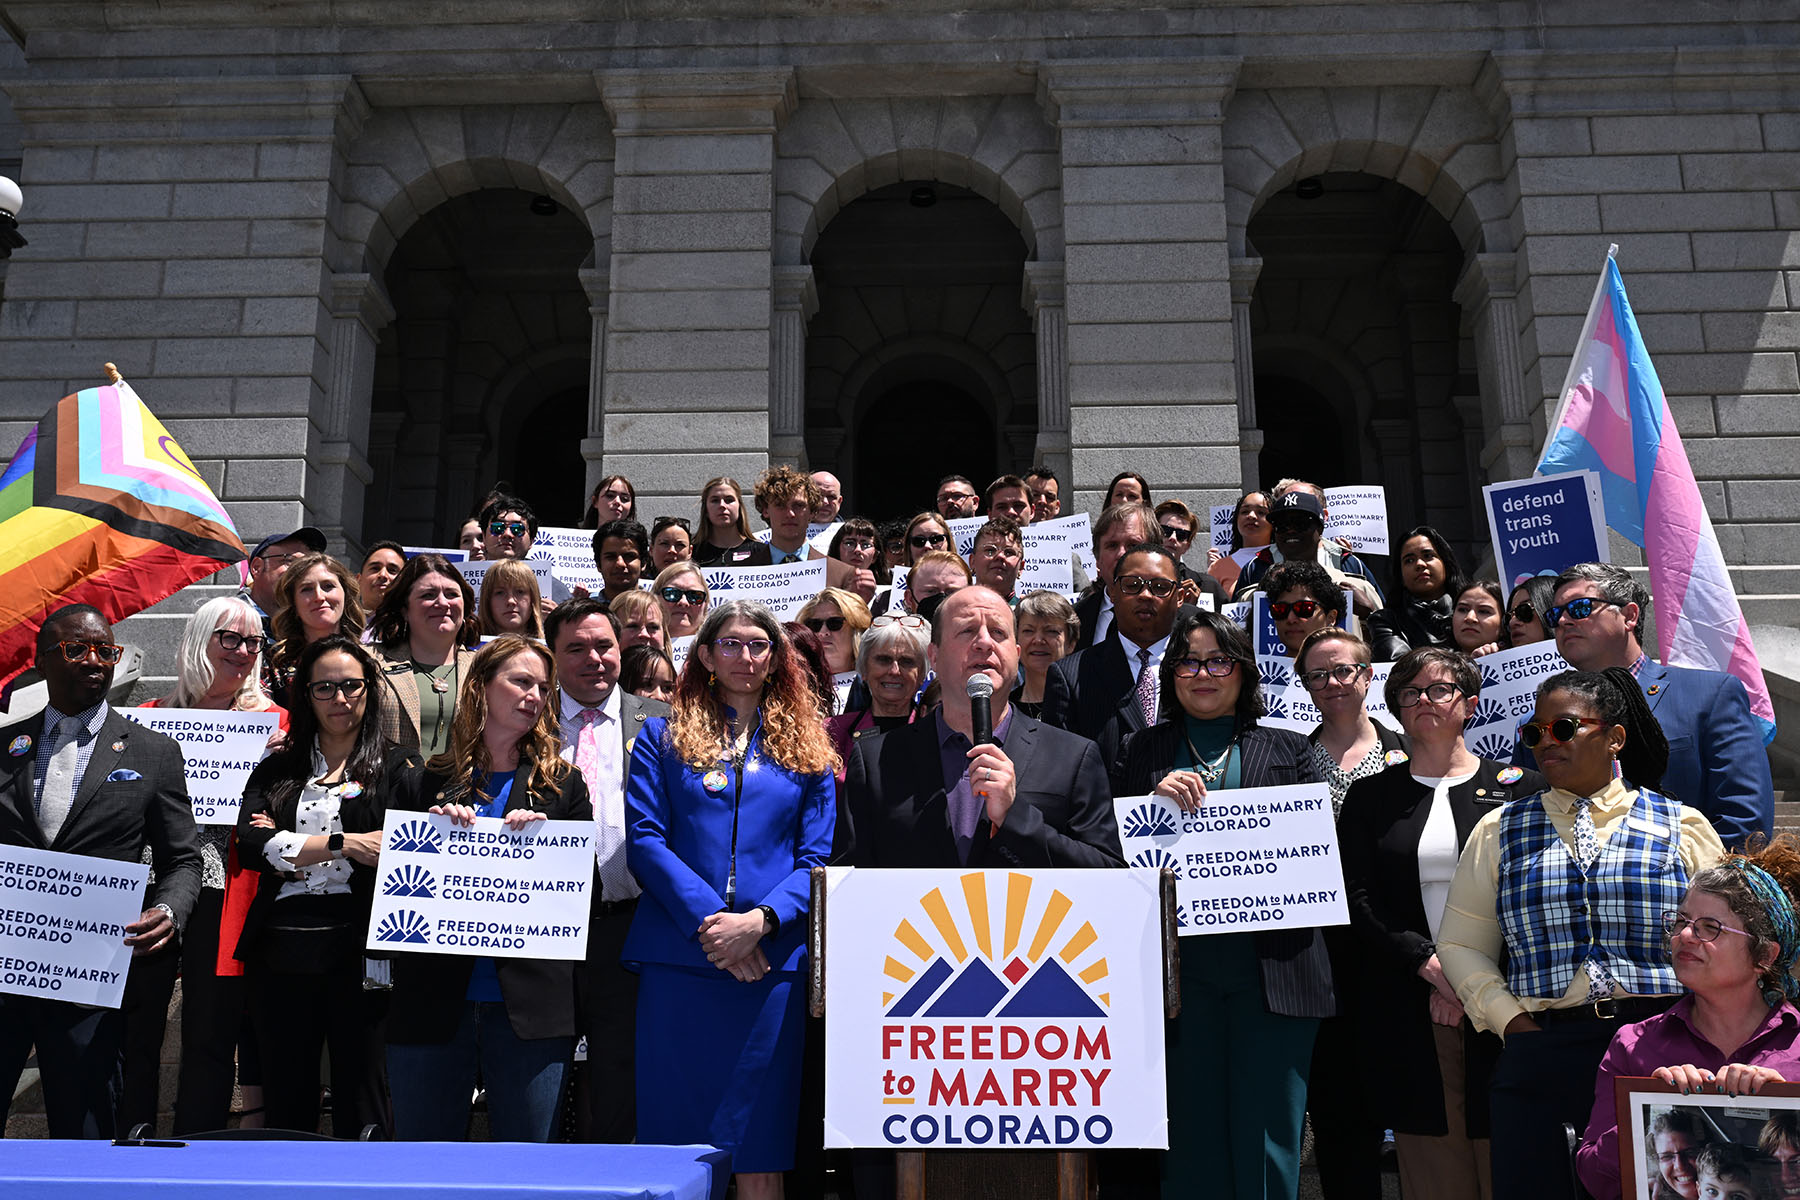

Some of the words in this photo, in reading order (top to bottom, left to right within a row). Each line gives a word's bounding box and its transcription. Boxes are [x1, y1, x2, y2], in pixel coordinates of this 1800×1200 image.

[1502, 489, 1564, 512] defend
[1324, 520, 1361, 528] OLORADO
[1505, 513, 1552, 532] trans
[1362, 536, 1386, 544] MARRY
[1508, 530, 1560, 554] youth
[738, 572, 782, 581] FREEDOM
[790, 567, 822, 577] MARRY
[738, 579, 790, 589] COLORADO
[1504, 661, 1568, 681] COLORAD
[150, 721, 214, 732] FREEDOM
[216, 723, 225, 731] to
[226, 723, 273, 735] MARRY
[211, 760, 220, 768] to
[221, 760, 259, 770] MARR
[206, 797, 215, 805] to
[1180, 804, 1256, 820] FREEDOM
[1258, 804, 1267, 814] to
[1269, 799, 1323, 814] MARRY
[1183, 817, 1271, 834] COLORADO
[449, 830, 522, 846] FREEDOM
[525, 836, 534, 846] to
[537, 836, 589, 848] MARRY
[448, 845, 535, 860] COLORADO
[1186, 850, 1262, 866] FREEDOM
[1264, 849, 1274, 859] to
[1276, 844, 1330, 859] MARRY
[1188, 862, 1277, 879] COLORADO
[73, 872, 84, 883] to
[85, 873, 139, 891] MARRY
[443, 875, 517, 889] FREEDOM
[520, 880, 529, 889] to
[532, 880, 585, 892] MARRY
[442, 889, 530, 904] COLORADO
[1192, 896, 1269, 912] FREEDOM
[1270, 895, 1280, 905] to
[1283, 890, 1337, 906] MARRY
[63, 918, 73, 929] to
[1194, 908, 1284, 926] COLORADO
[438, 920, 512, 934] FREEDOM
[515, 925, 525, 934] to
[527, 925, 581, 937] MARRY
[436, 933, 525, 949] COLORADO
[53, 964, 64, 976] to
[65, 966, 120, 984] MARRY
[883, 1025, 1111, 1060] FREEDOM
[883, 1069, 915, 1104] to
[928, 1068, 1112, 1106] MARRY
[883, 1114, 1113, 1144] COLORADO
